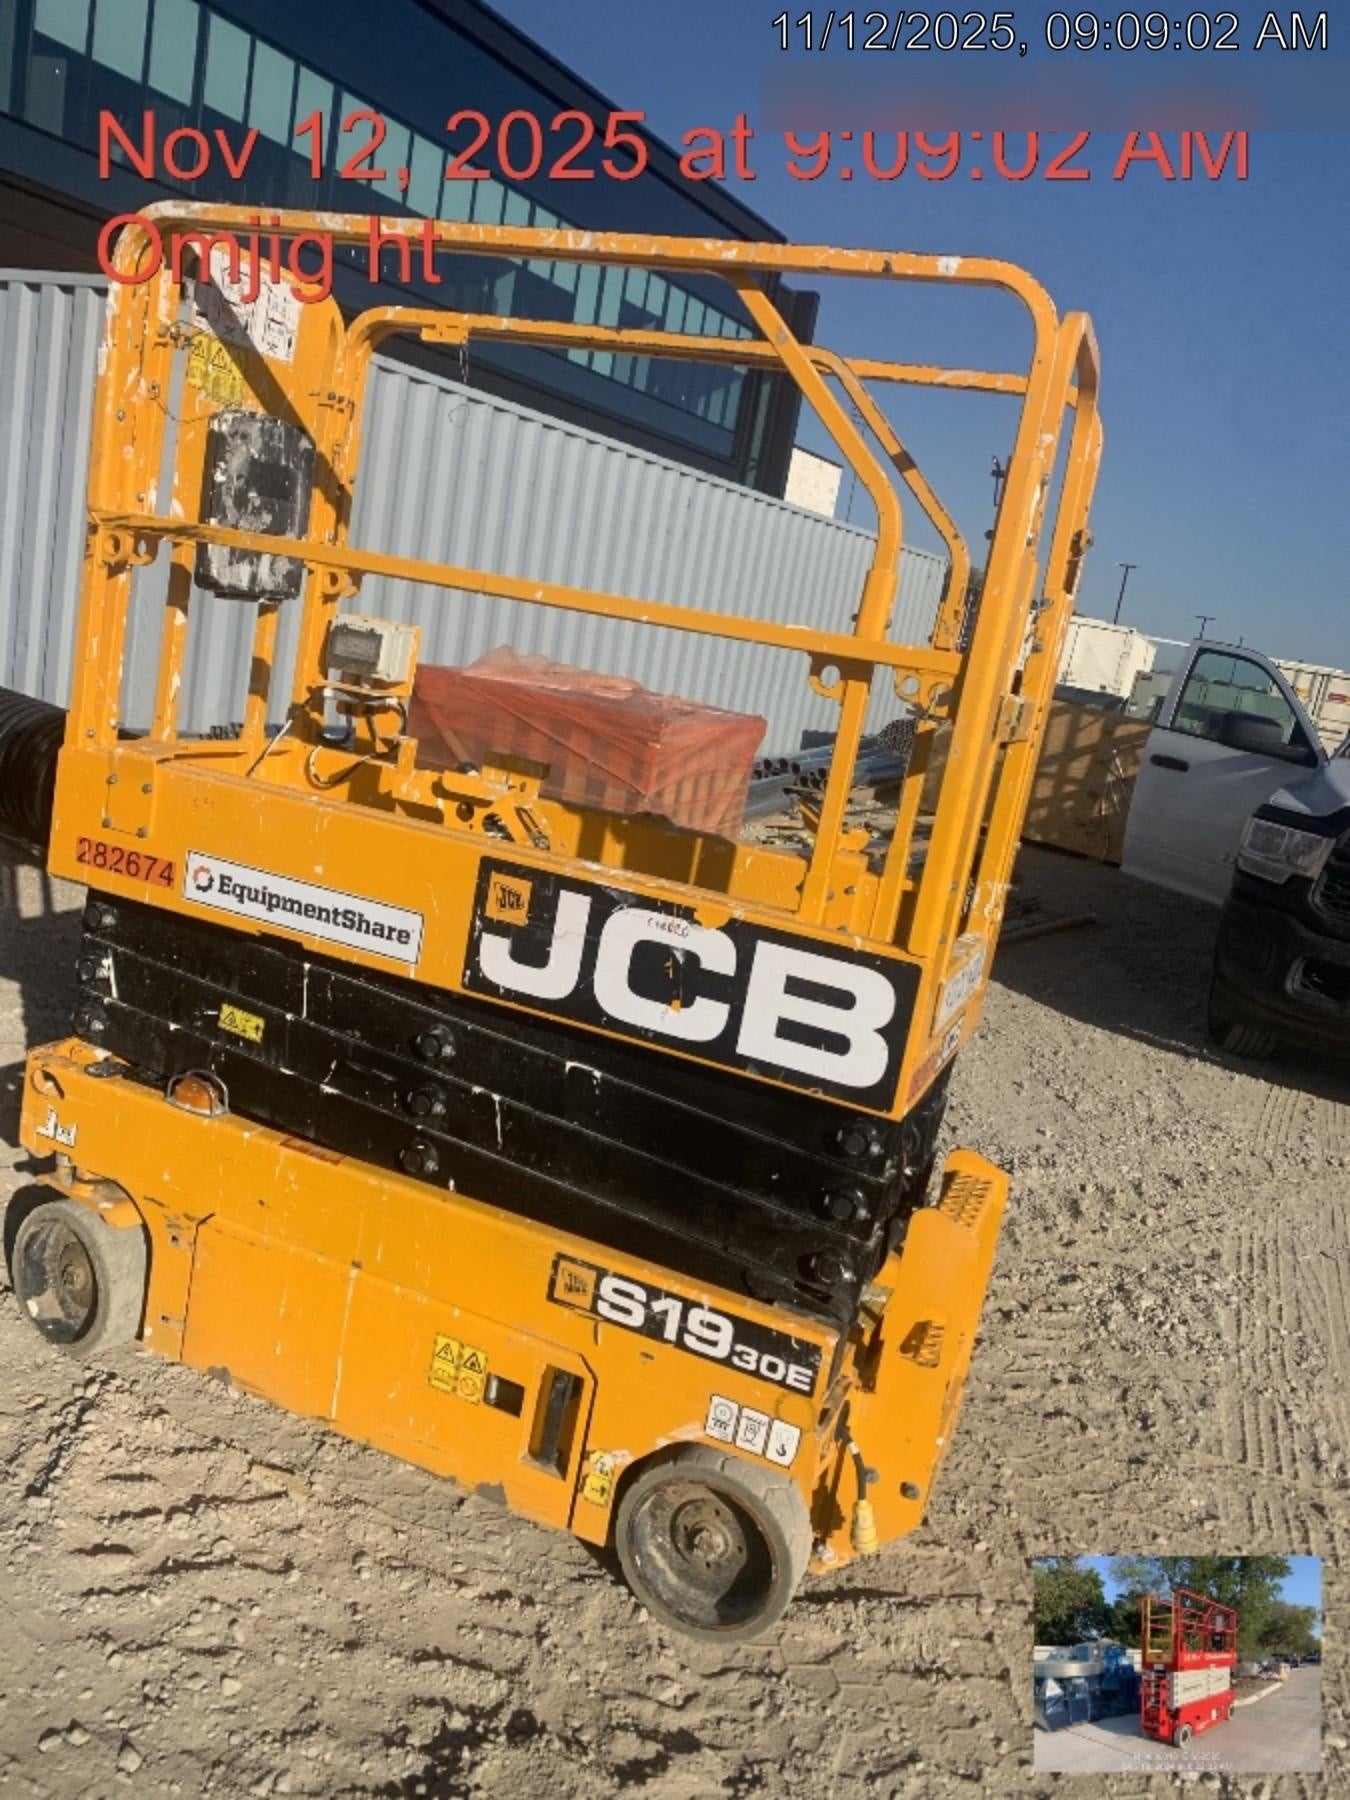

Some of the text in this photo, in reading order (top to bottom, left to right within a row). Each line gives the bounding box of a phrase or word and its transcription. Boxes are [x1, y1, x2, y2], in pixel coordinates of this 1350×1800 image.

[77, 837, 175, 888] 282674
[217, 873, 412, 945] EquipmentShare
[479, 889, 897, 1089] JCB
